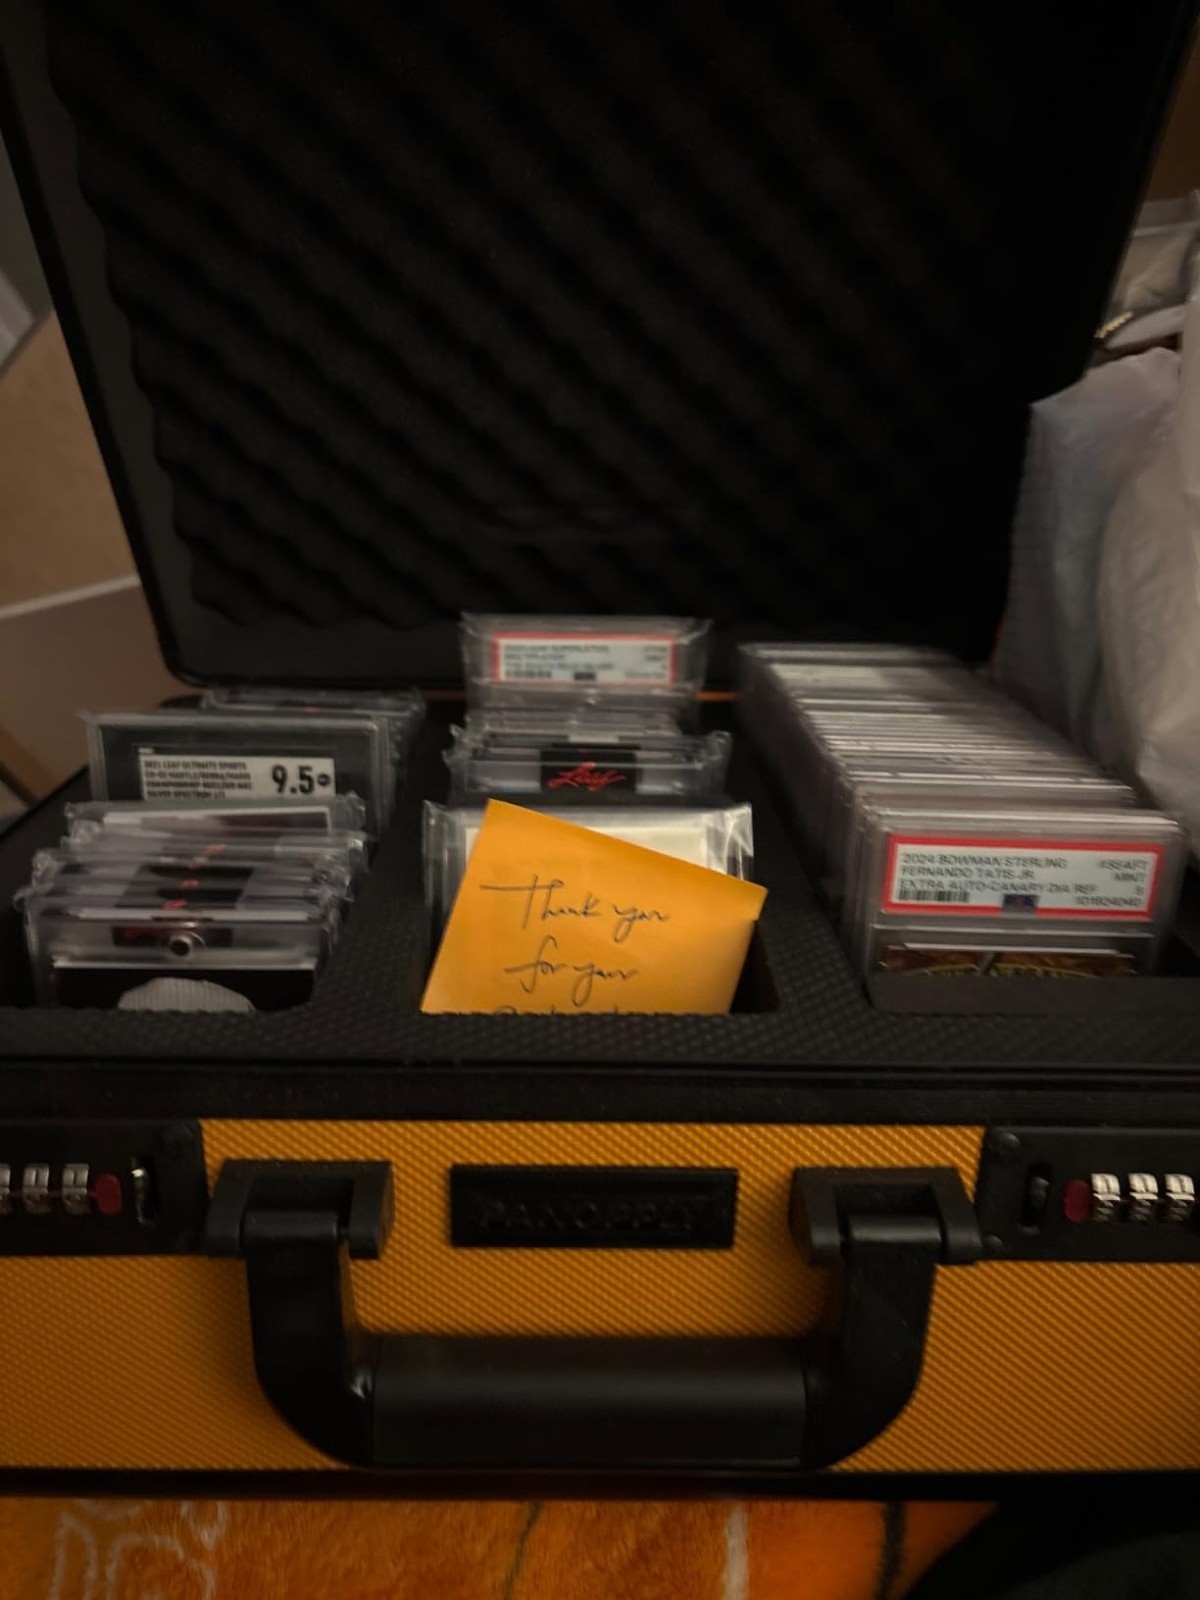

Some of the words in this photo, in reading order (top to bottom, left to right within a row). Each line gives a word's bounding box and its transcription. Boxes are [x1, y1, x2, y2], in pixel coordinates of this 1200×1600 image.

[272, 764, 315, 795] 9.5
[938, 853, 1001, 868] BOWMAN
[1003, 855, 1068, 870] STERLING
[901, 866, 973, 880] FERNANDO
[975, 868, 1015, 881] TATIS
[1113, 872, 1146, 883] MINT
[899, 878, 946, 892] EXTRA
[479, 873, 602, 931] Thank
[503, 934, 568, 996] for
